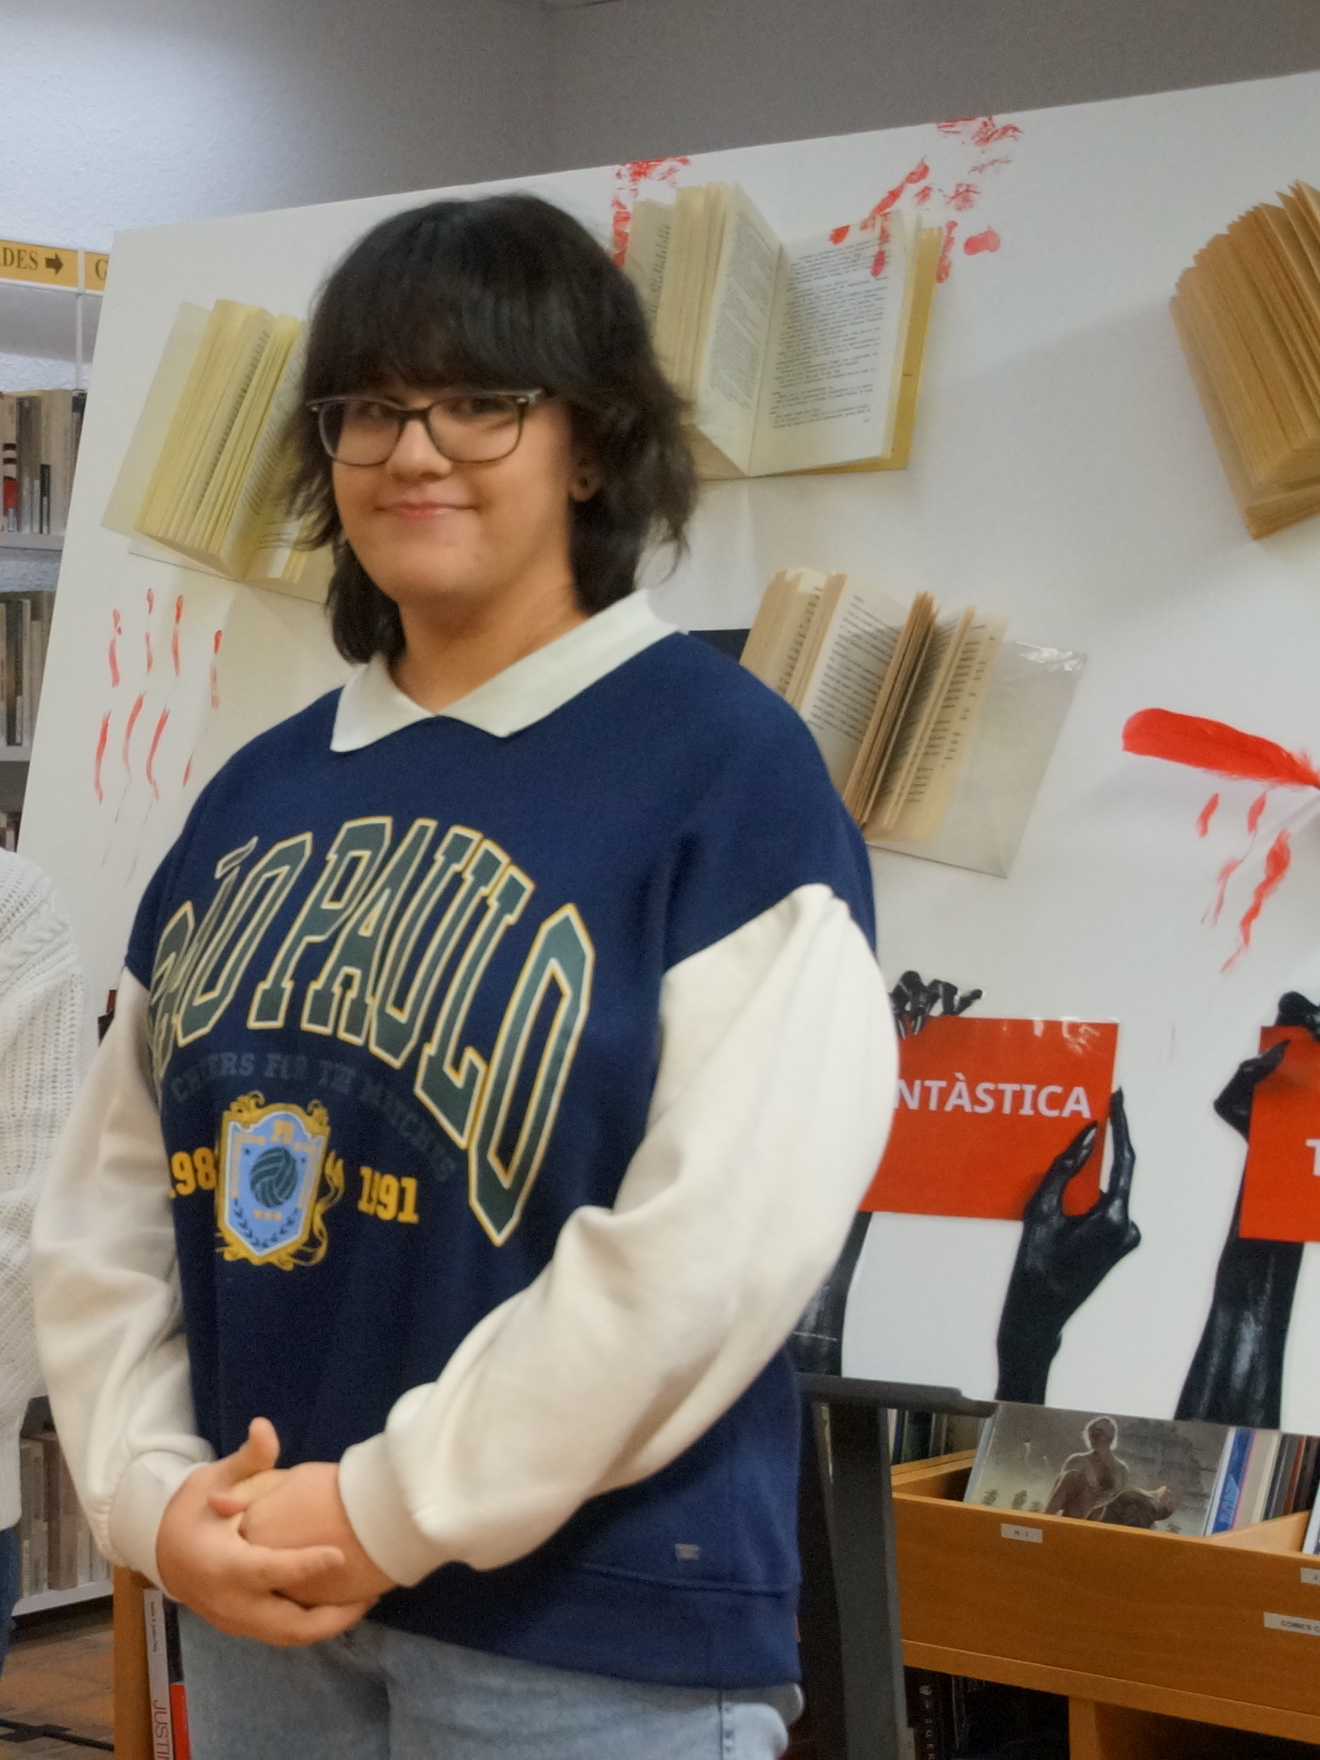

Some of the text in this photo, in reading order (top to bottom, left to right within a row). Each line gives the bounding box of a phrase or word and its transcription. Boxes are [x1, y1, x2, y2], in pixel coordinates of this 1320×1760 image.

[247, 815, 596, 1248] PAULO
[894, 1072, 1092, 1119] NTÀSTICA
[152, 1700, 171, 1760] JUSTI
